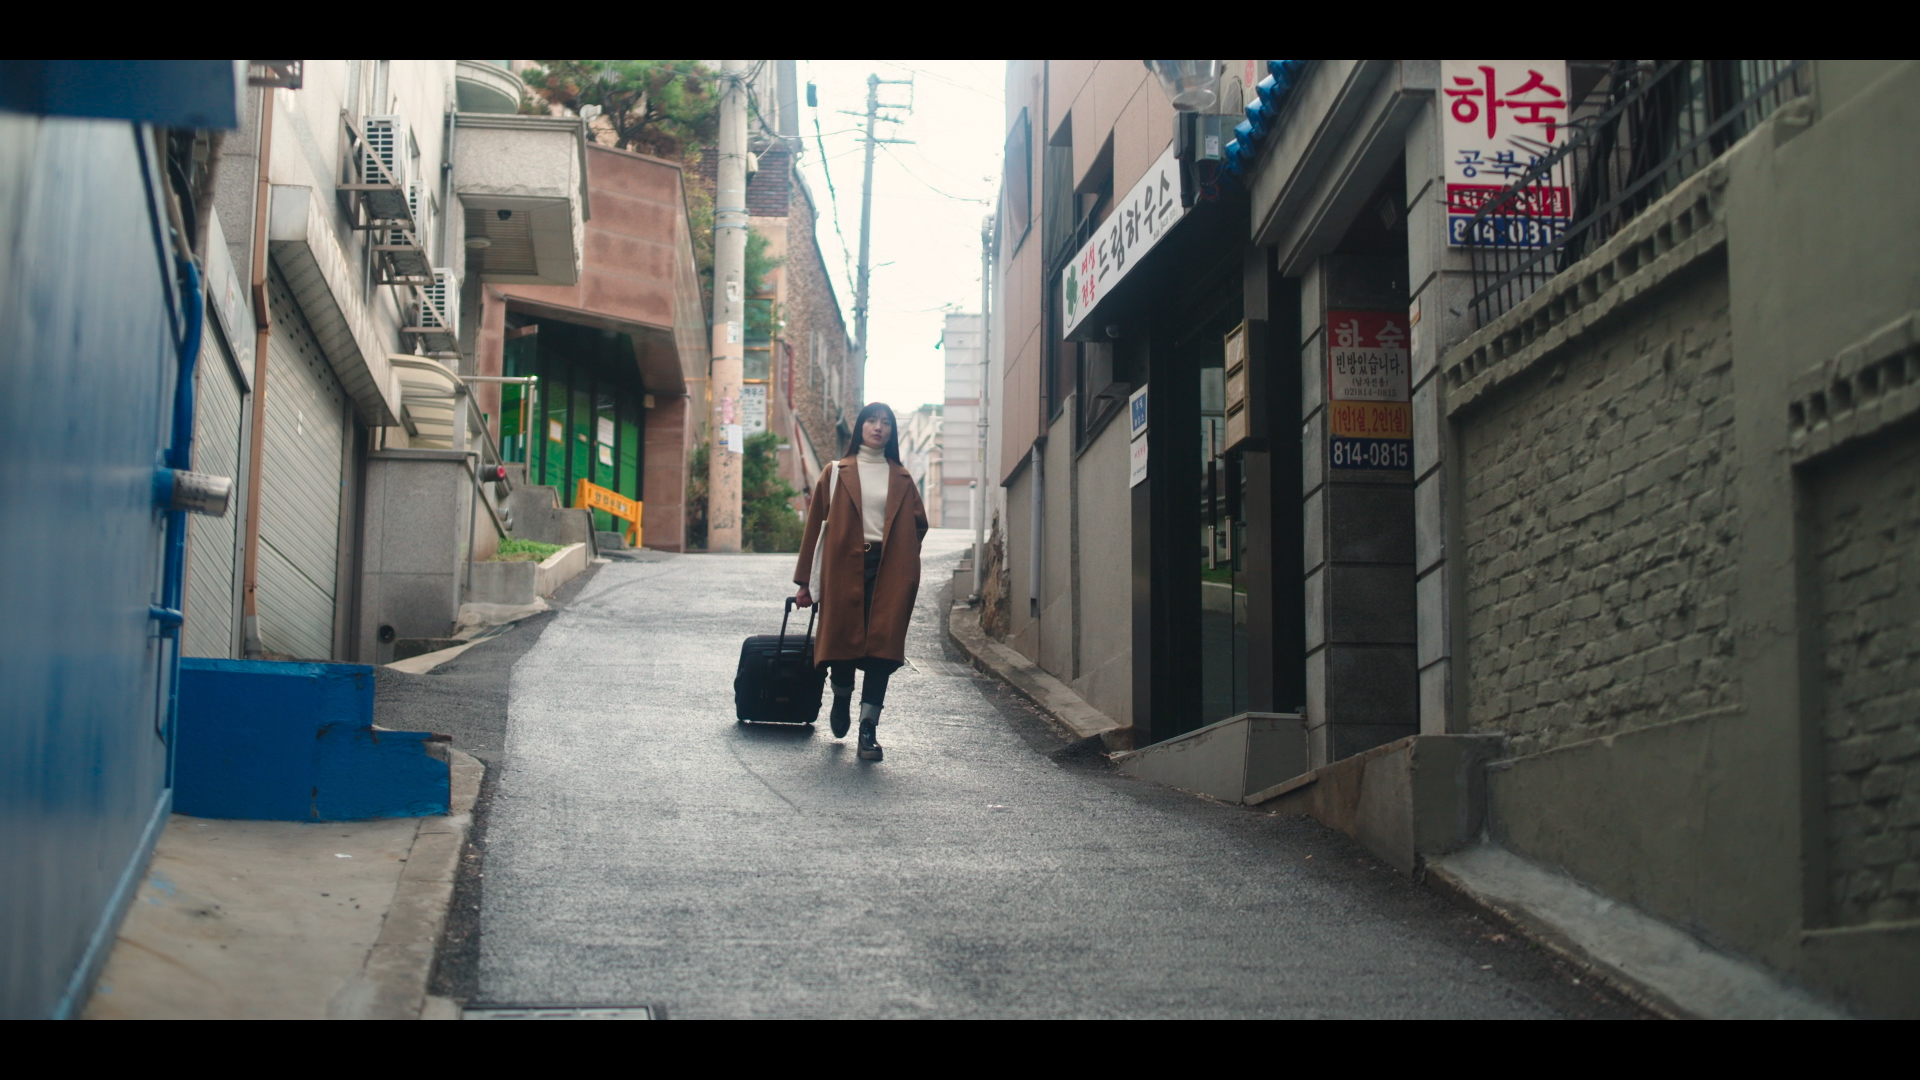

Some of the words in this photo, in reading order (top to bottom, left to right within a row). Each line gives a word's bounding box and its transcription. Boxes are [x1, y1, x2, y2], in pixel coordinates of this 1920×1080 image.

[1444, 65, 1567, 143] 하숙
[1098, 169, 1173, 283] 드림하우스
[1081, 241, 1096, 276] 여성
[1081, 273, 1096, 308] 전용
[1344, 387, 1397, 397] 02)814-0815
[1352, 377, 1389, 388] (남자전용)
[1334, 441, 1408, 467] 814-0815
